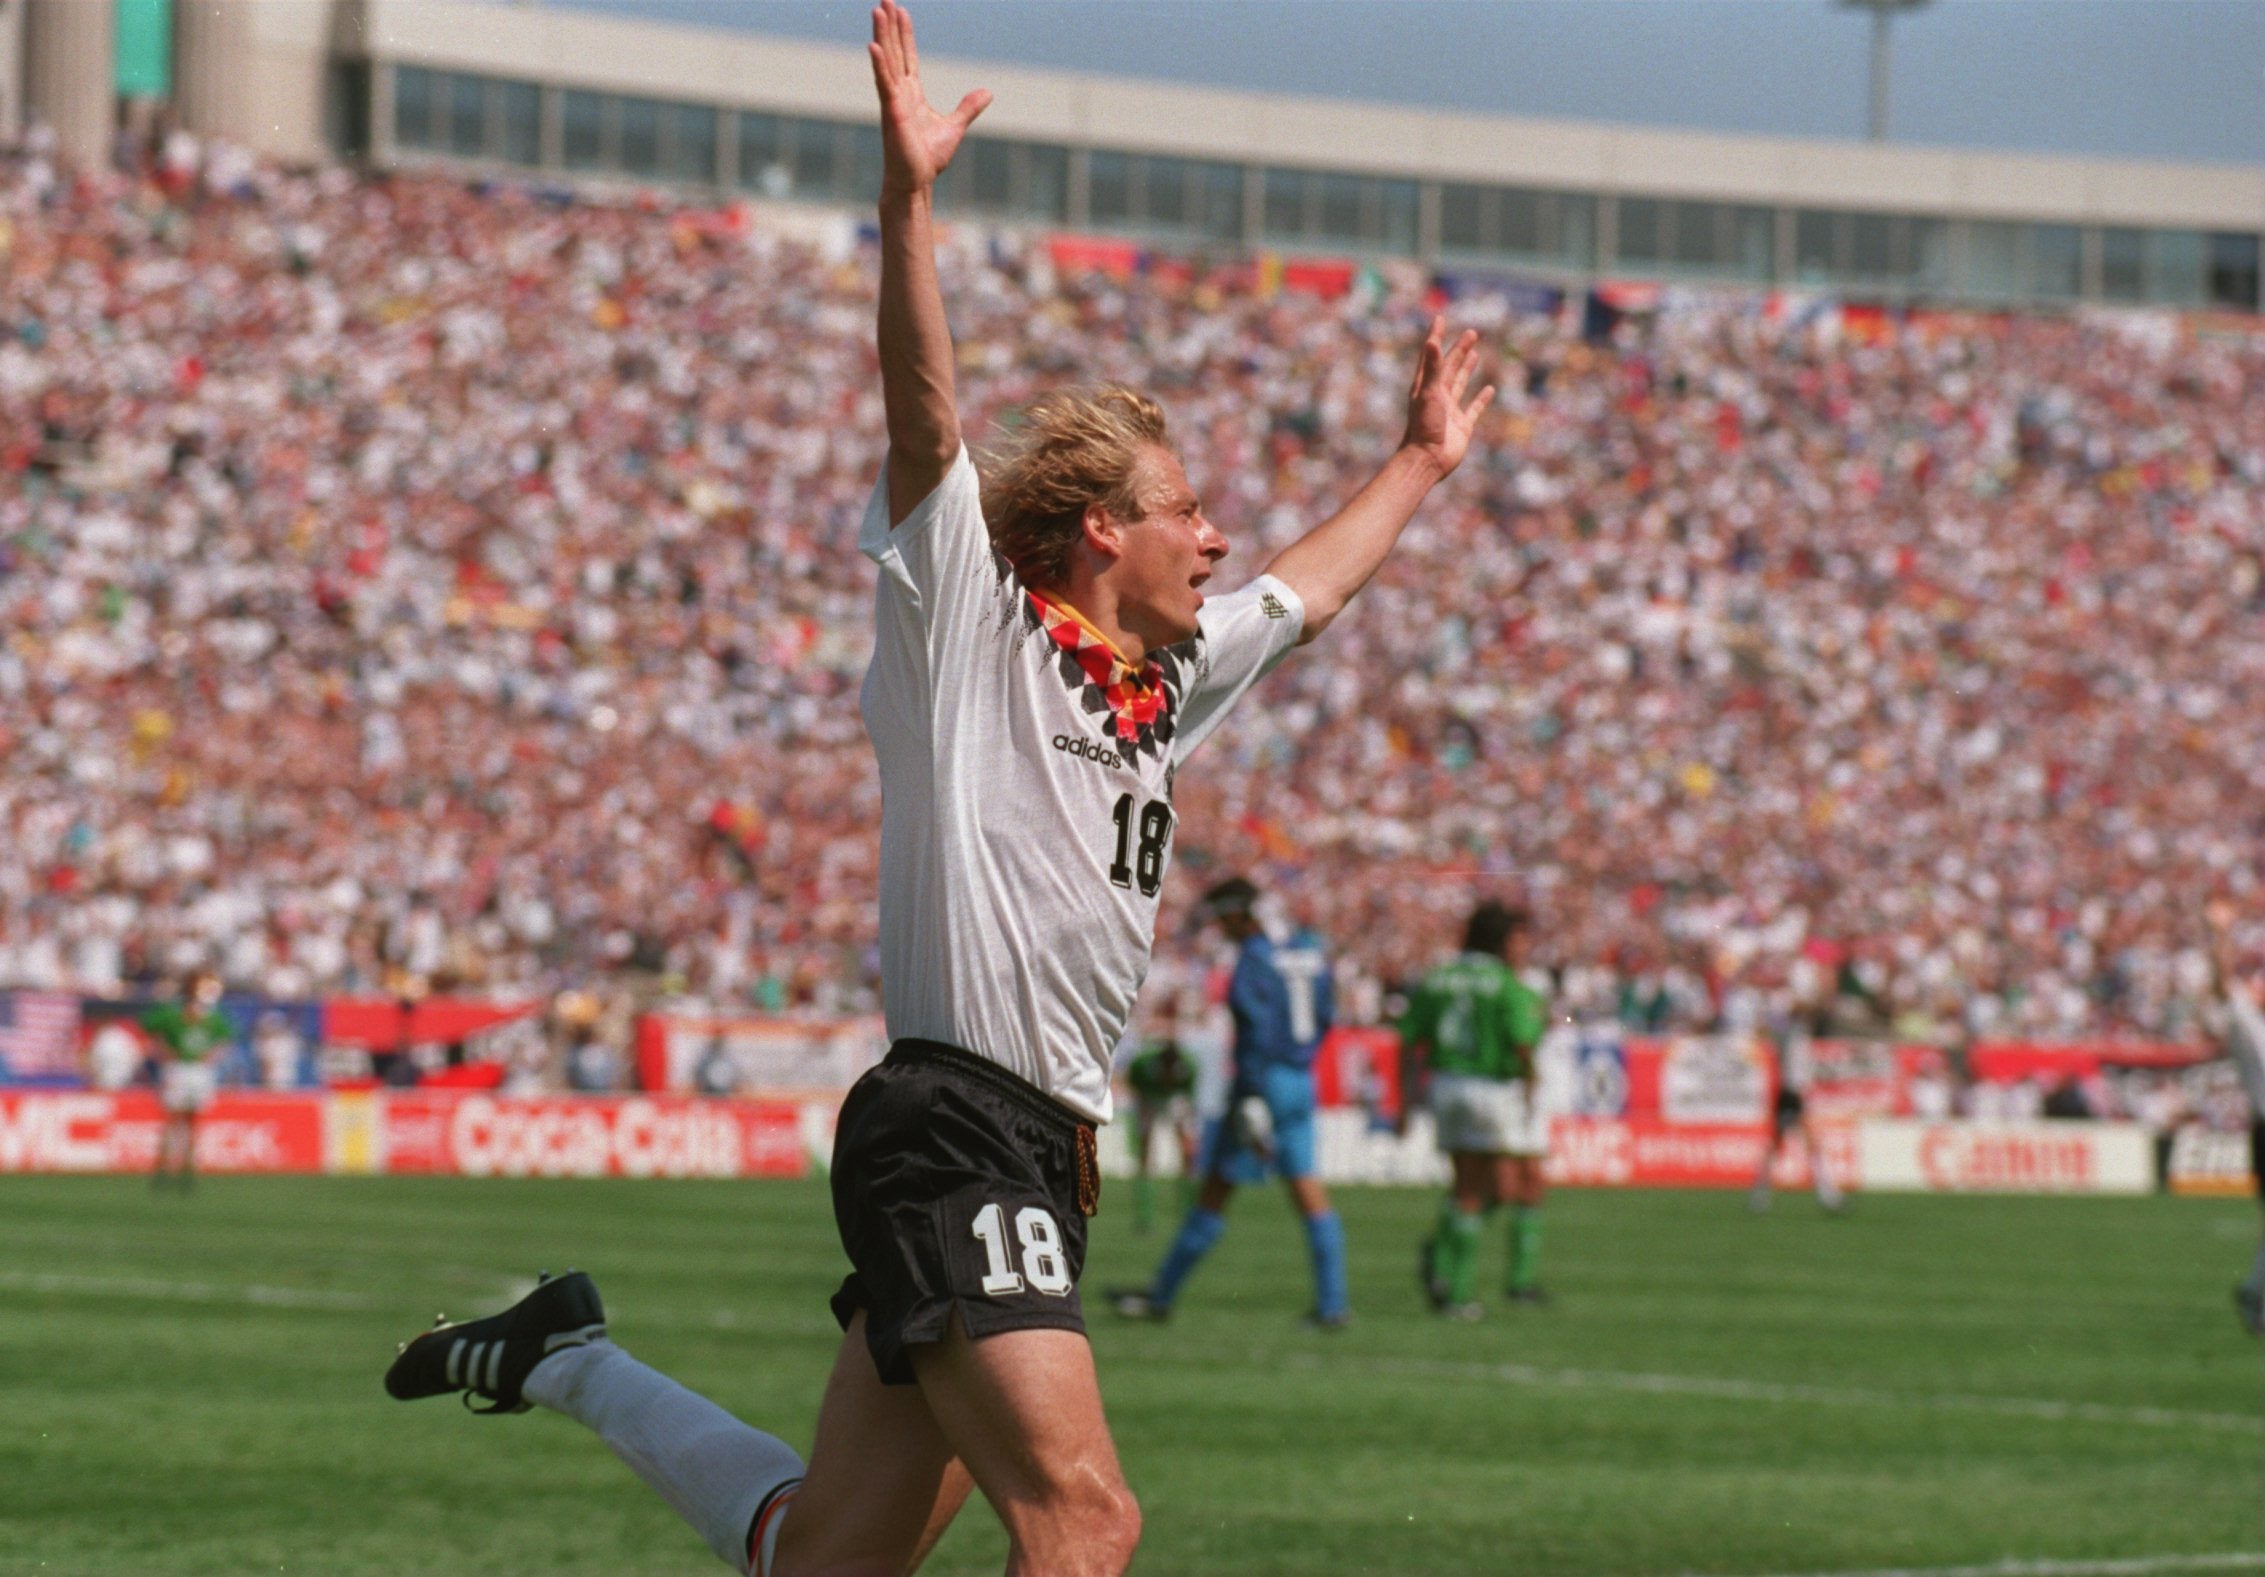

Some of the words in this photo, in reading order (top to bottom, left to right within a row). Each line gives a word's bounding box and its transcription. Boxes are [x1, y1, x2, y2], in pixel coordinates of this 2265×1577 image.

[1052, 733, 1123, 770] adidas
[1110, 792, 1173, 899] 18
[453, 1095, 742, 1177] Coca-Cola
[971, 1202, 1072, 1297] 18
